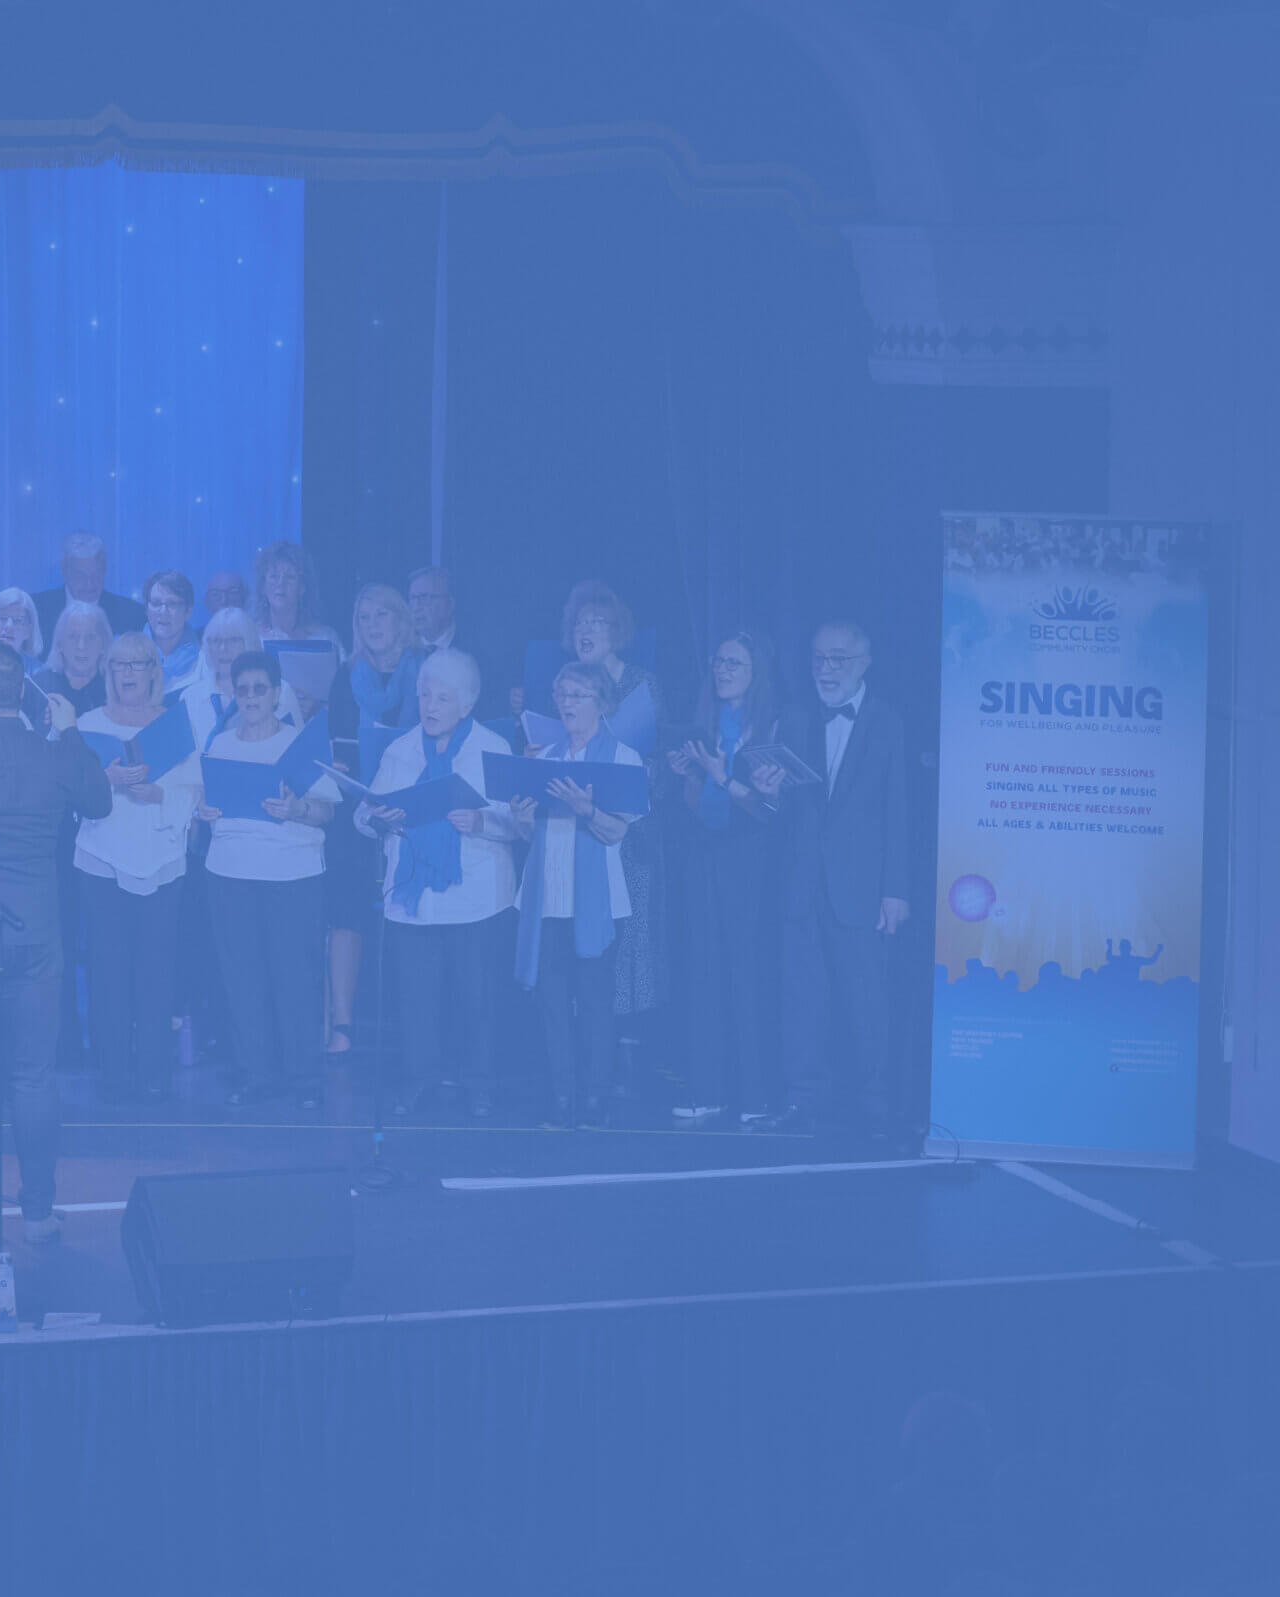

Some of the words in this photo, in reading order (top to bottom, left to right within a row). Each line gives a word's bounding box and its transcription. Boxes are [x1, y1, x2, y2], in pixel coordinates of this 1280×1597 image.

[1029, 624, 1120, 642] BECCLES
[979, 680, 1163, 720] SINGING
[980, 719, 1003, 729] FOR
[1007, 719, 1072, 731] WELLBEING
[1075, 722, 1099, 732] AND
[1102, 723, 1161, 735] PLEASURE
[985, 763, 1009, 773] FUN
[1013, 764, 1038, 774] AND
[1041, 765, 1096, 776] FRIENDLY
[1100, 767, 1155, 778] SESSIONS
[985, 781, 1034, 793] SINGING
[1038, 783, 1058, 793] ALL
[1063, 784, 1098, 795] TYPES
[1102, 785, 1117, 796] OF
[1120, 787, 1157, 798] MUSIC
[990, 799, 1007, 809] NO
[1011, 800, 1081, 813] EXPERIENCE
[1085, 803, 1152, 816] NECESSARY
[977, 818, 998, 828] ALL
[1003, 819, 1031, 829] AGES
[1036, 820, 1044, 829] &
[1049, 821, 1103, 833] ABILITIES
[1106, 823, 1165, 835] WELCOME
